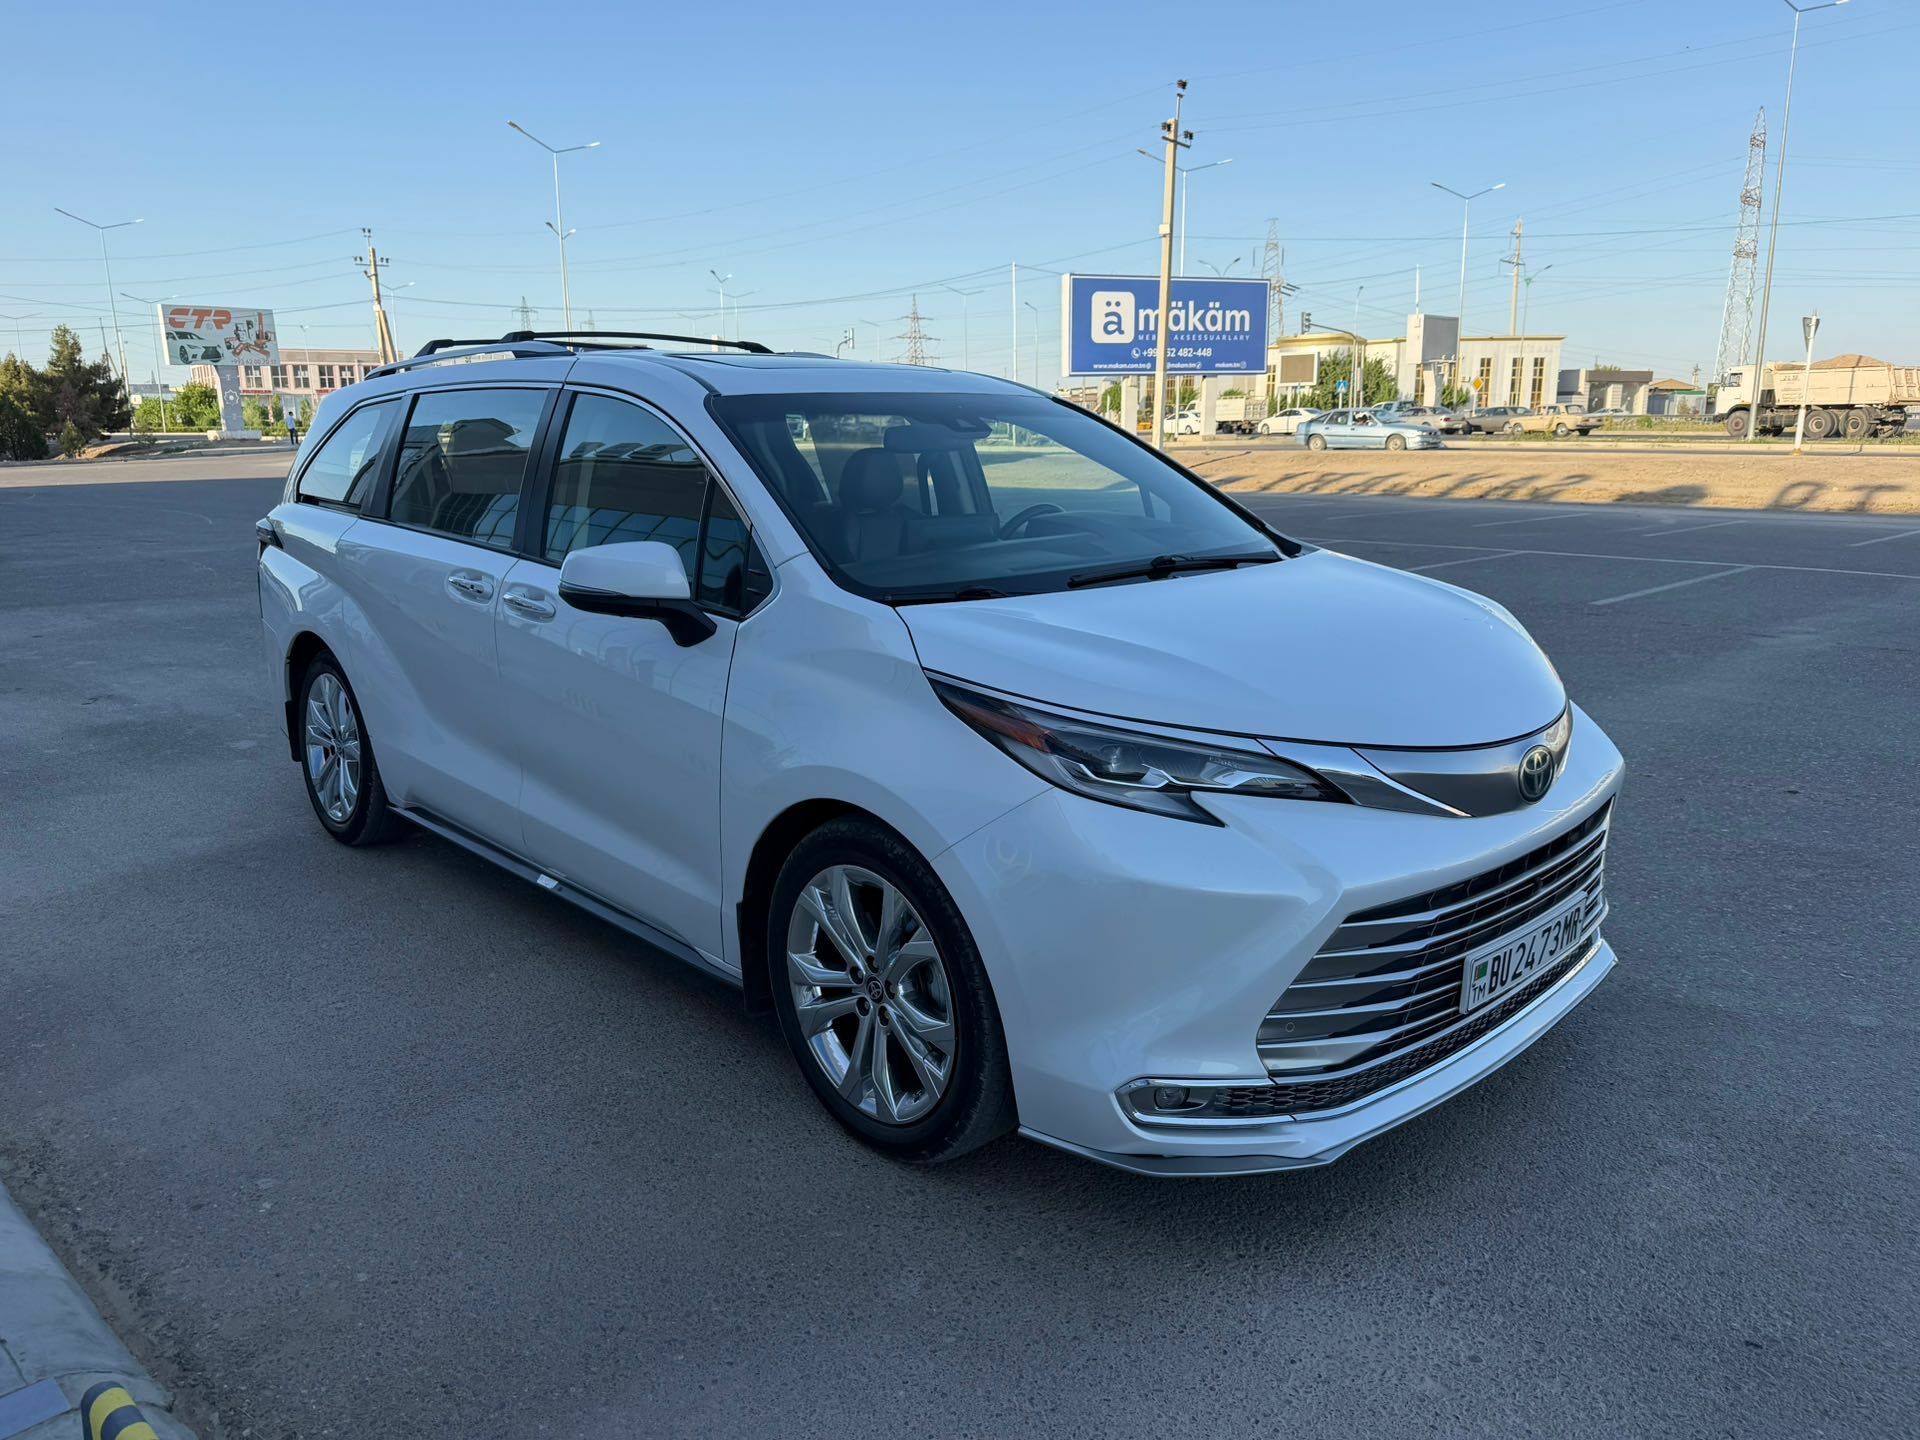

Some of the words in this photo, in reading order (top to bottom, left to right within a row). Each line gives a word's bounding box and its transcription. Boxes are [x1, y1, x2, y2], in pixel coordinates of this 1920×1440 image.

[168, 308, 232, 330] CTR
[1138, 301, 1250, 332] mäkäm
[1142, 348, 1158, 357] +99
[1177, 348, 1212, 357] 482-448
[1487, 906, 1581, 995] BU2473MR
[1472, 982, 1487, 1004] TM
